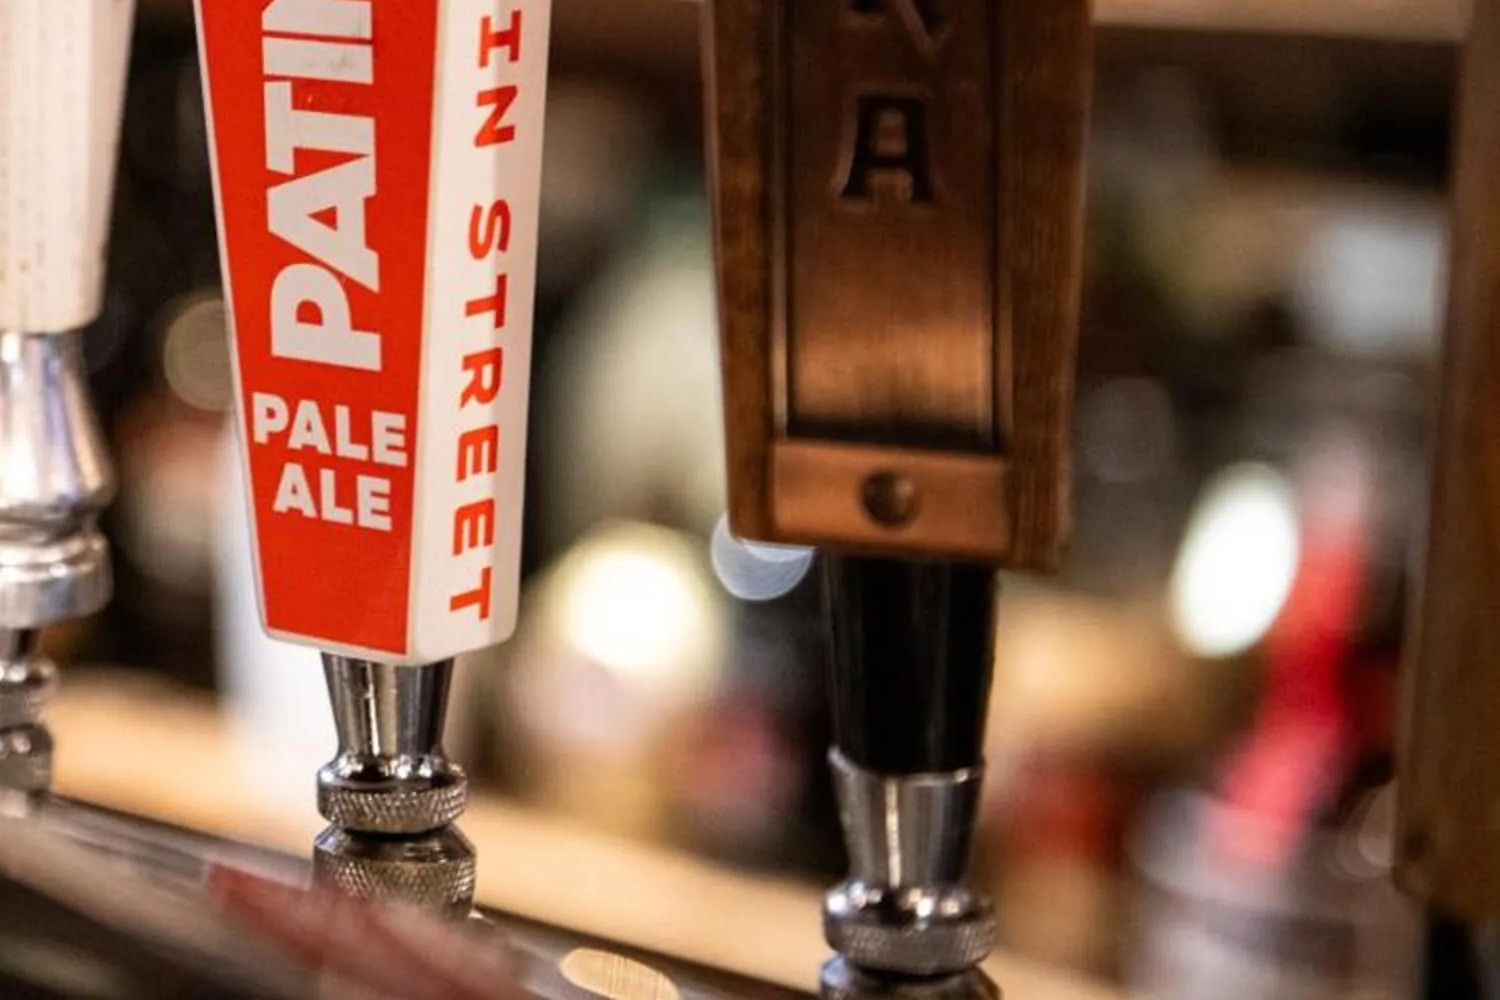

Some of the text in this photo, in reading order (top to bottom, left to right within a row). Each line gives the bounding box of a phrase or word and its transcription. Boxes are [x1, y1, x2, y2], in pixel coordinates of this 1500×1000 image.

[252, 390, 408, 468] PALE
[450, 198, 512, 622] STREET
[272, 461, 393, 532] ALE
